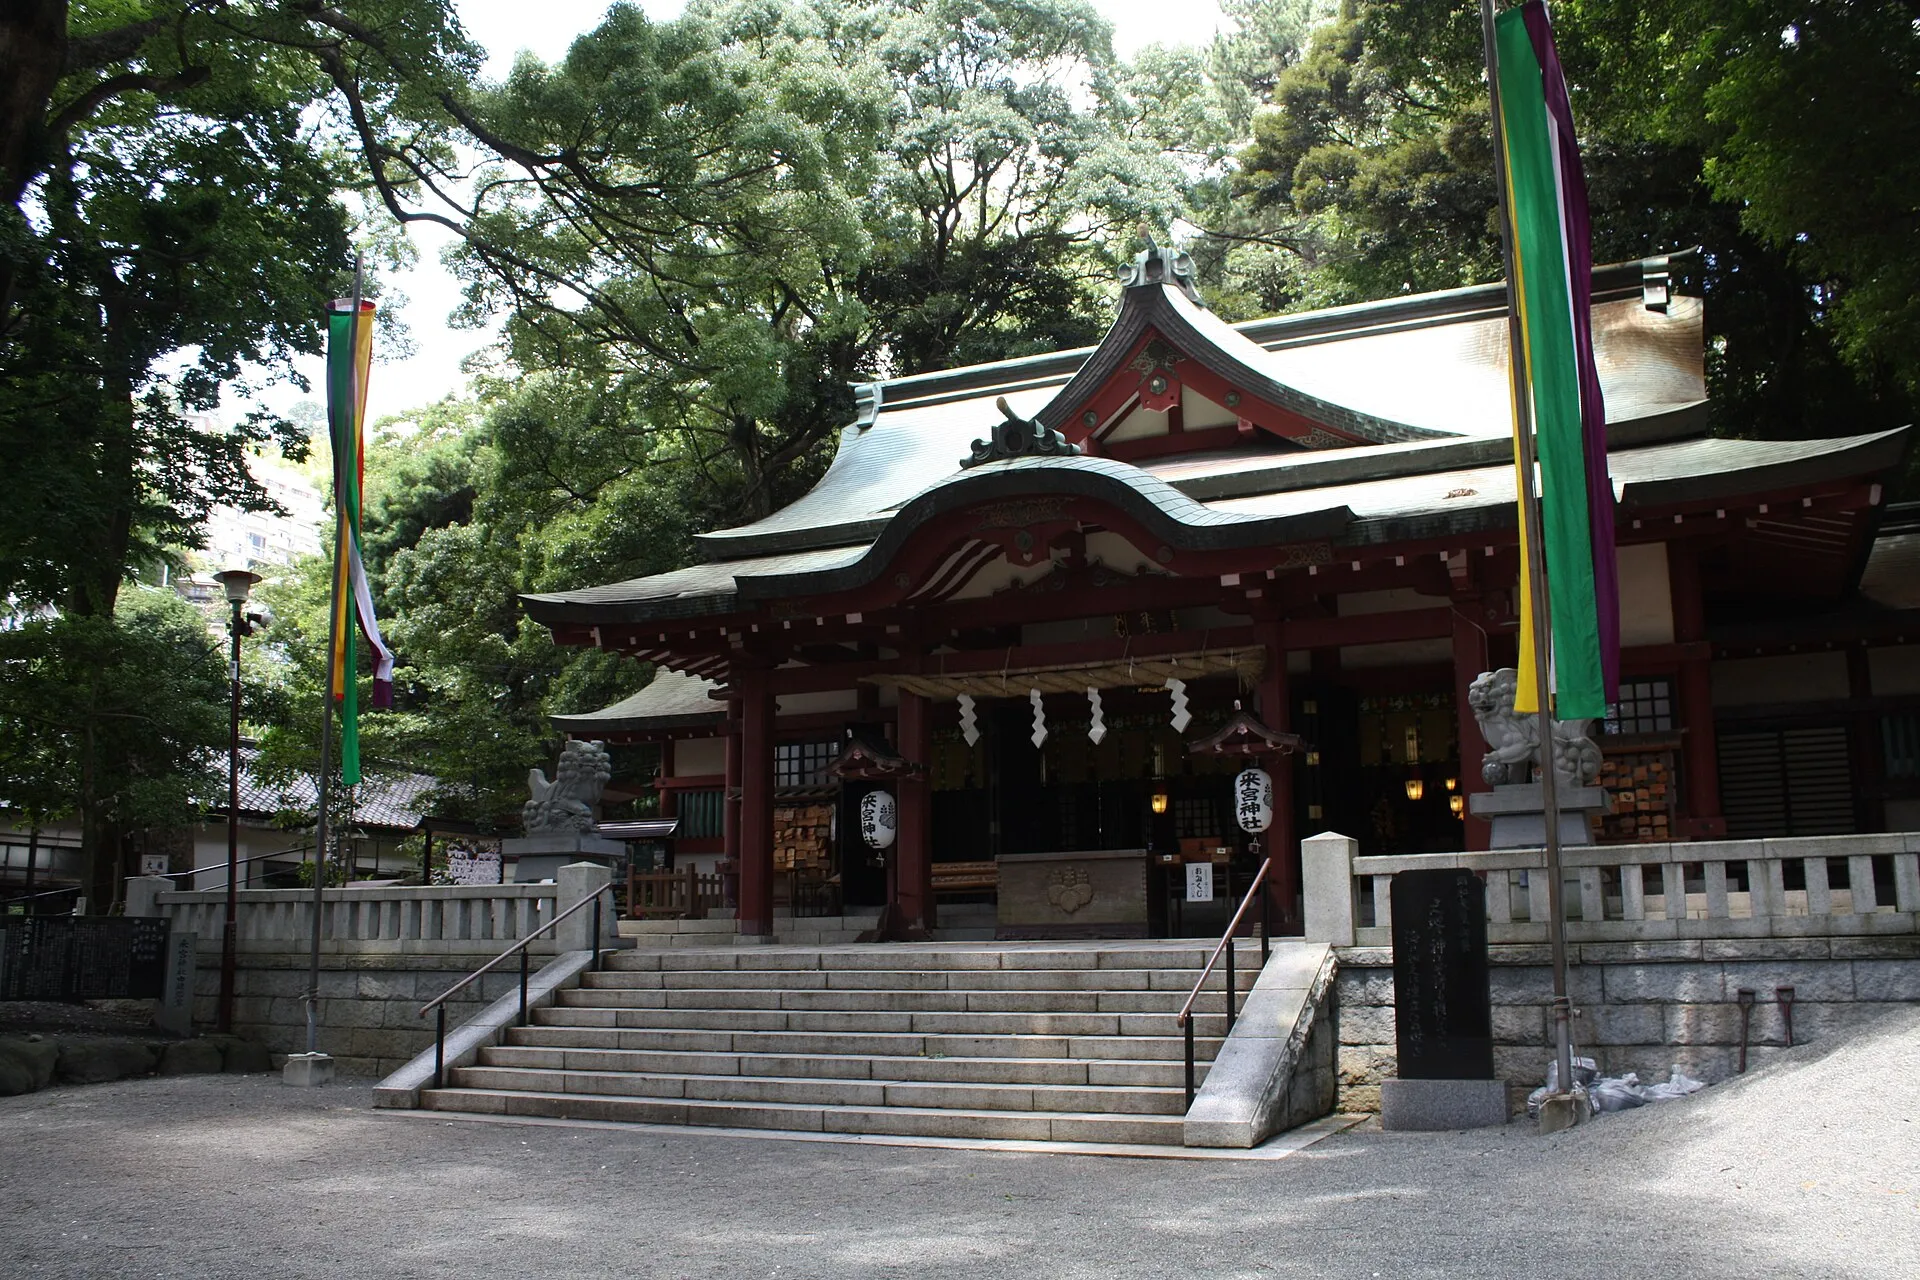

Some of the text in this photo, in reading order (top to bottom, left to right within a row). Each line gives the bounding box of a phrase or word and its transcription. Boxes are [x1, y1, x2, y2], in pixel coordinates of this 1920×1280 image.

[862, 794, 881, 847] 来宮神社
[1239, 771, 1263, 830] 来宮神社
[1195, 868, 1203, 898] おみくじ
